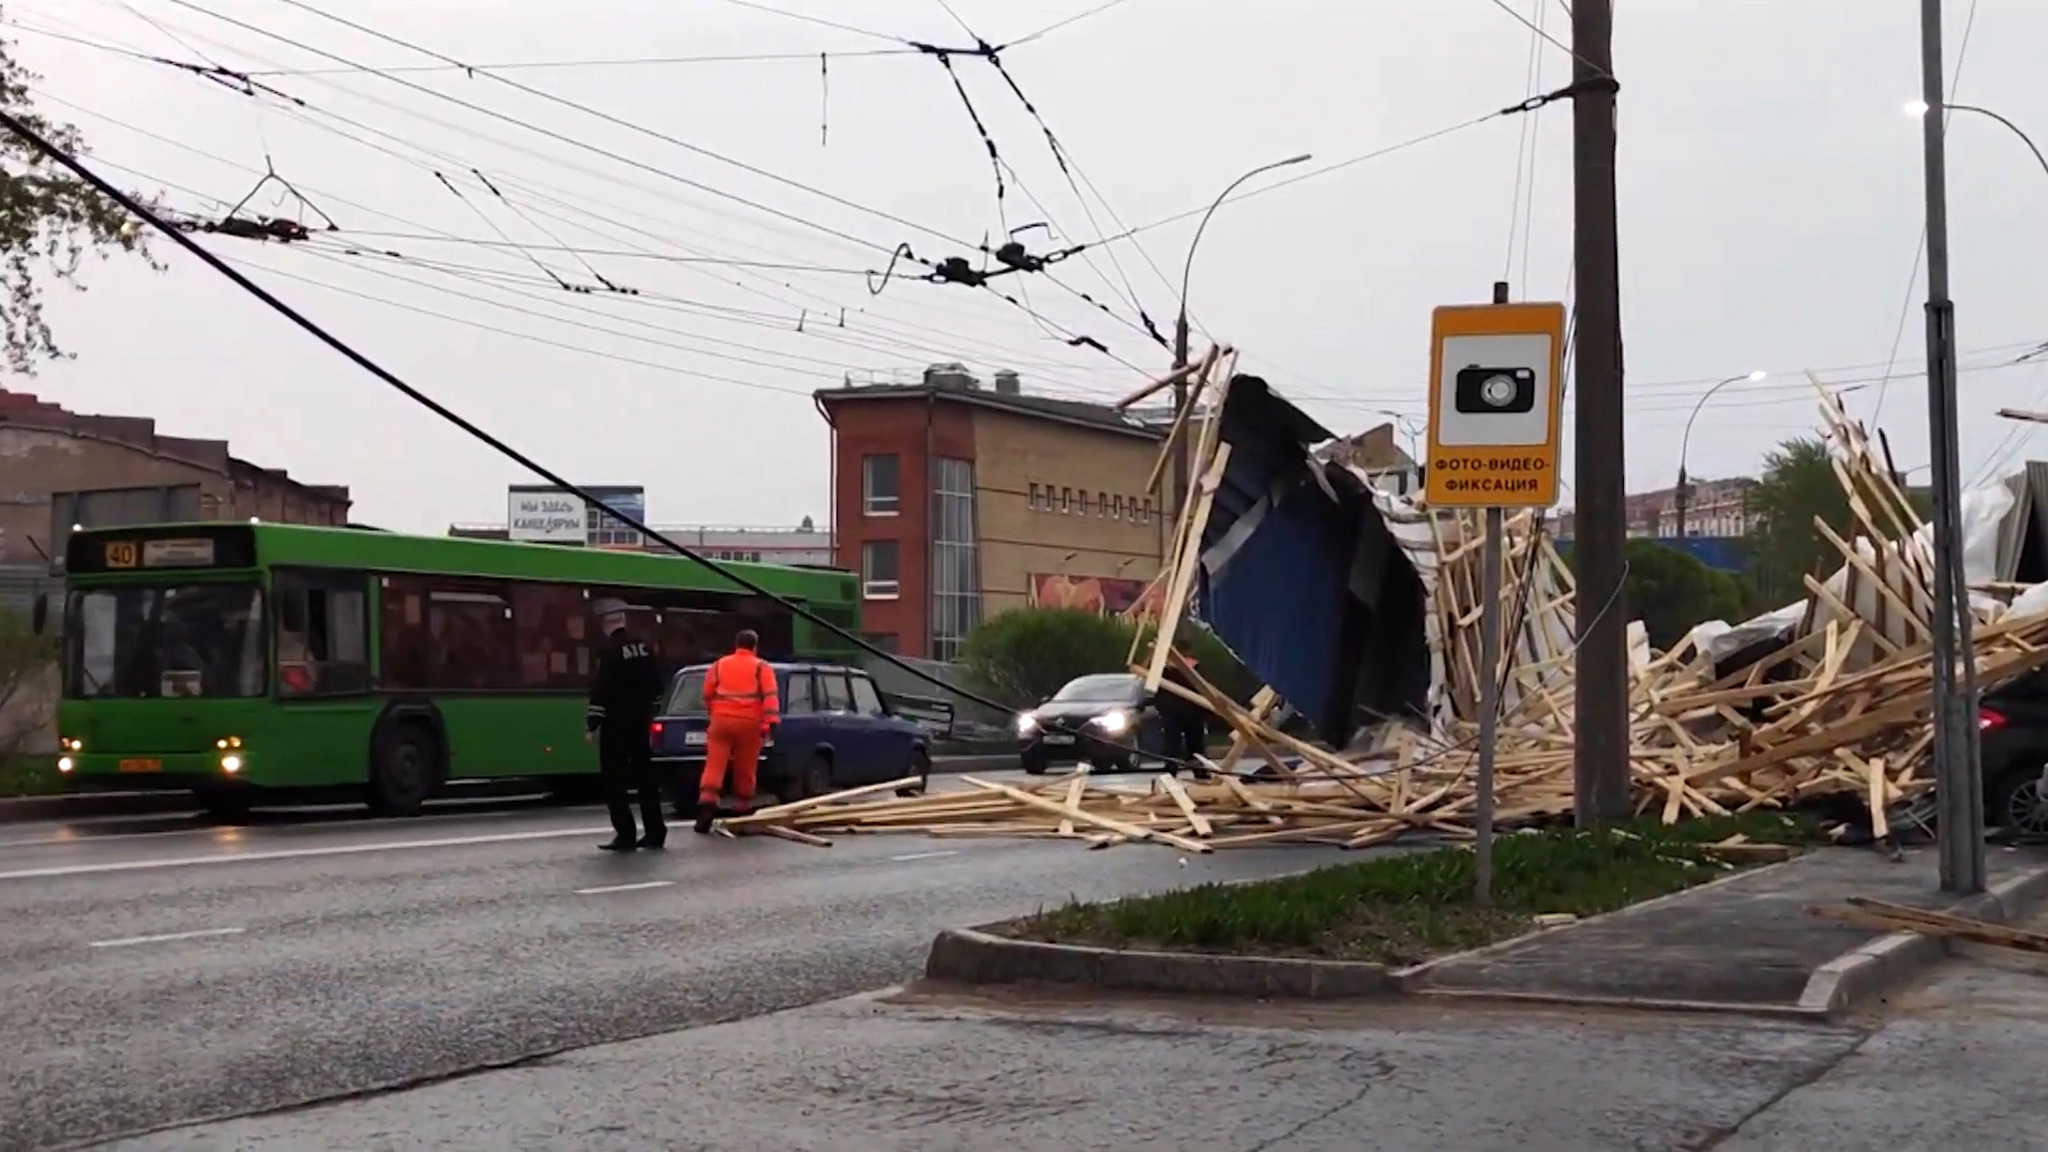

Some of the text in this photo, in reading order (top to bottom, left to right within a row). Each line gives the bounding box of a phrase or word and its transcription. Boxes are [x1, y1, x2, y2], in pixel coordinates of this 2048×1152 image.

[1435, 458, 1550, 471] ФОТО-ВИДЕО-
[1445, 479, 1538, 491] ФИКСАЦИЯ
[110, 544, 133, 565] 40
